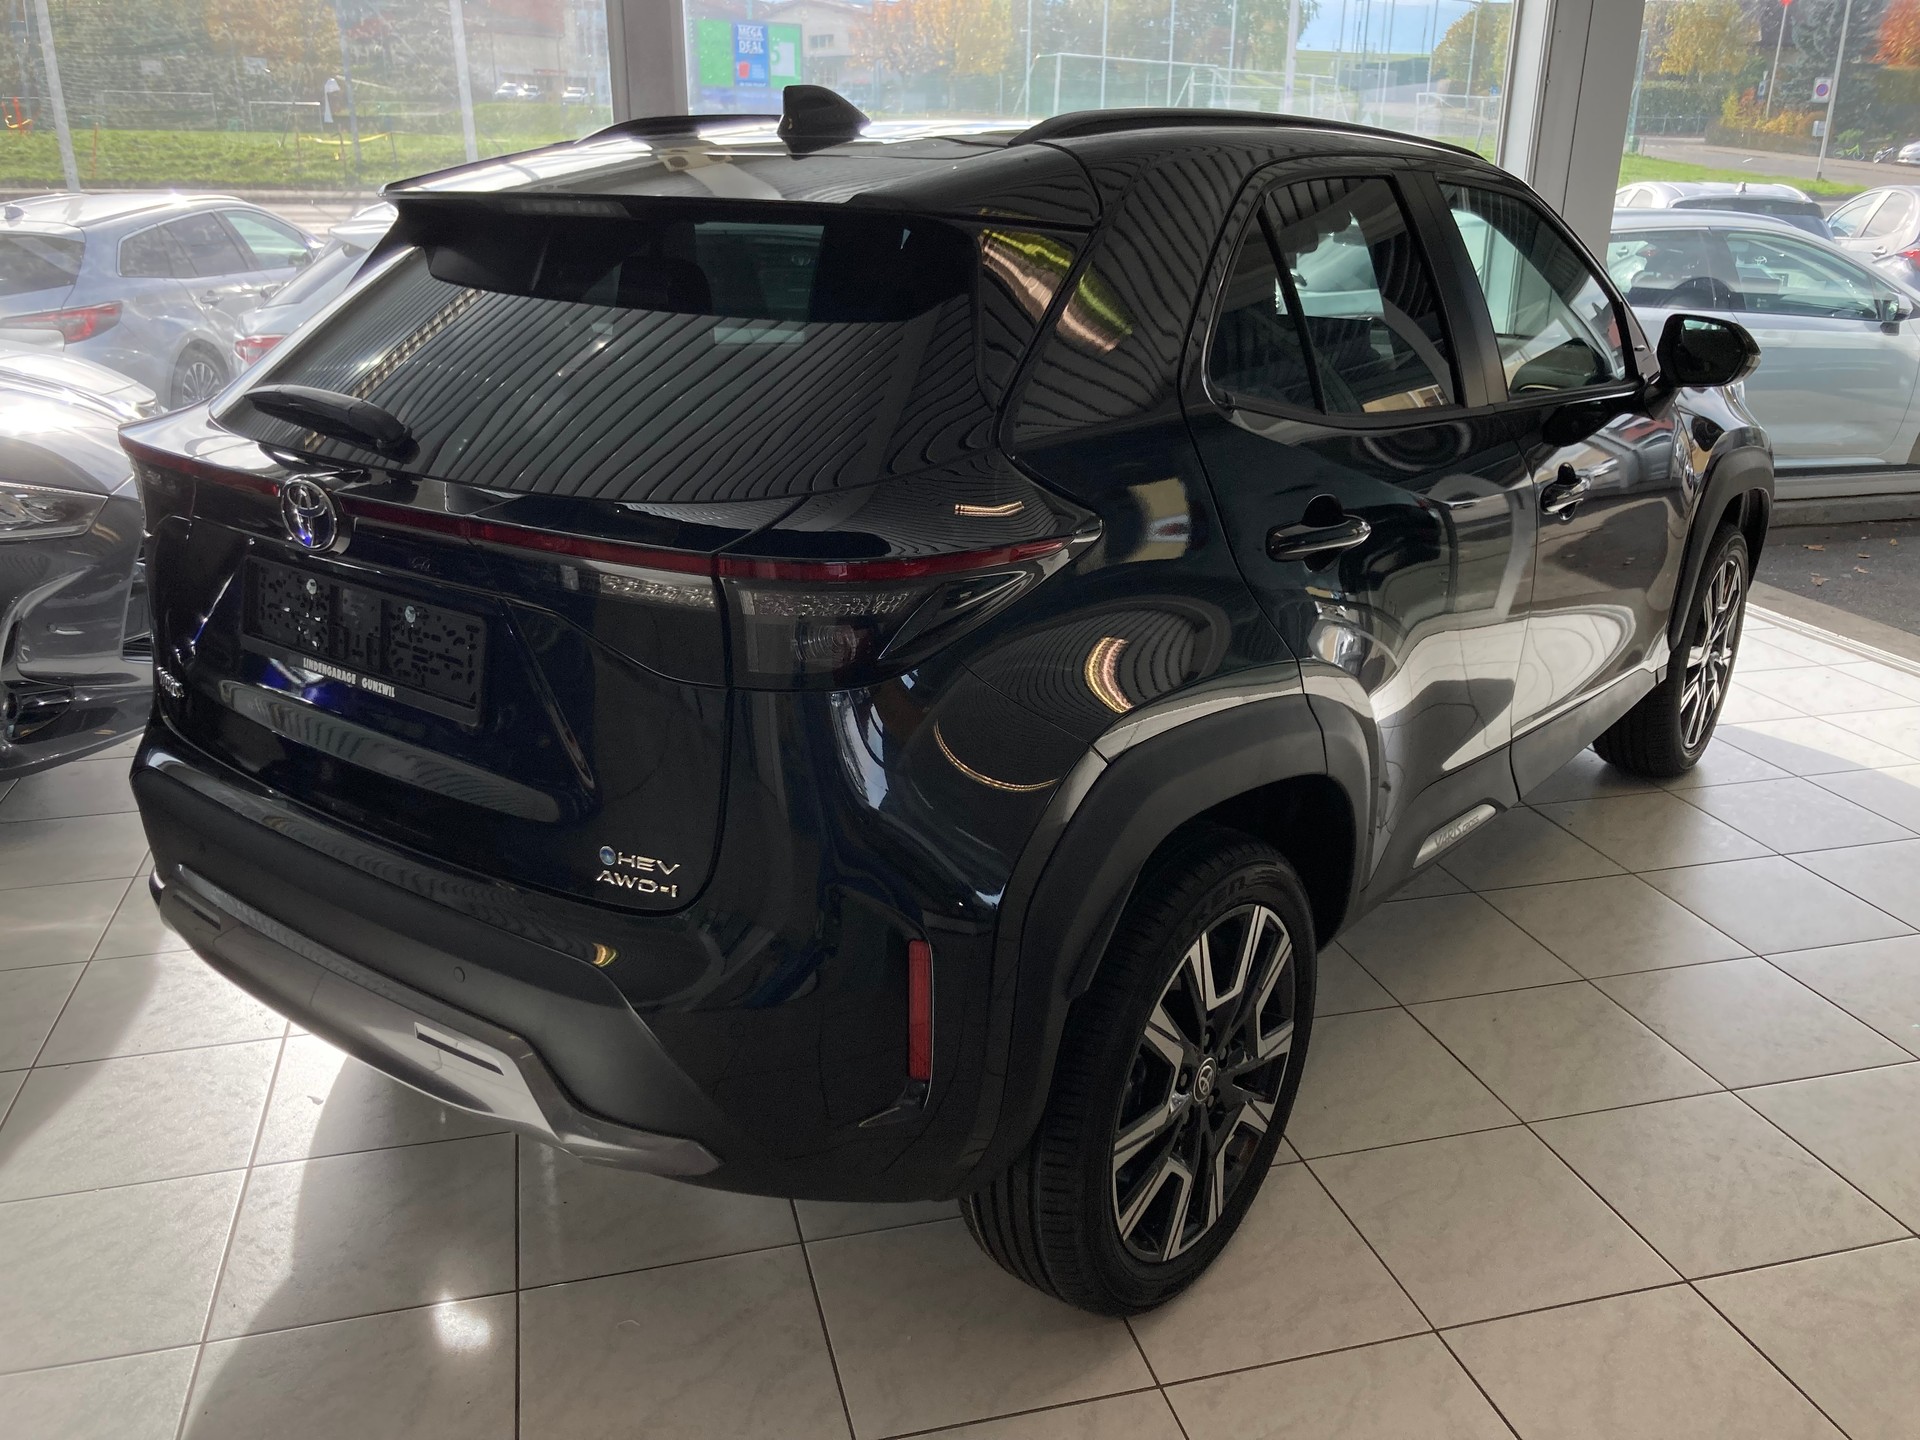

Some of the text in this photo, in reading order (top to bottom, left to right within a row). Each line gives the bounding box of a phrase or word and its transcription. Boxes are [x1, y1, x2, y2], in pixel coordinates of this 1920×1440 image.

[737, 26, 763, 38] MEGA
[738, 40, 763, 51] DEAL
[303, 657, 396, 698] LINDENGARAGE GUNZWIL
[617, 851, 681, 875] HEV
